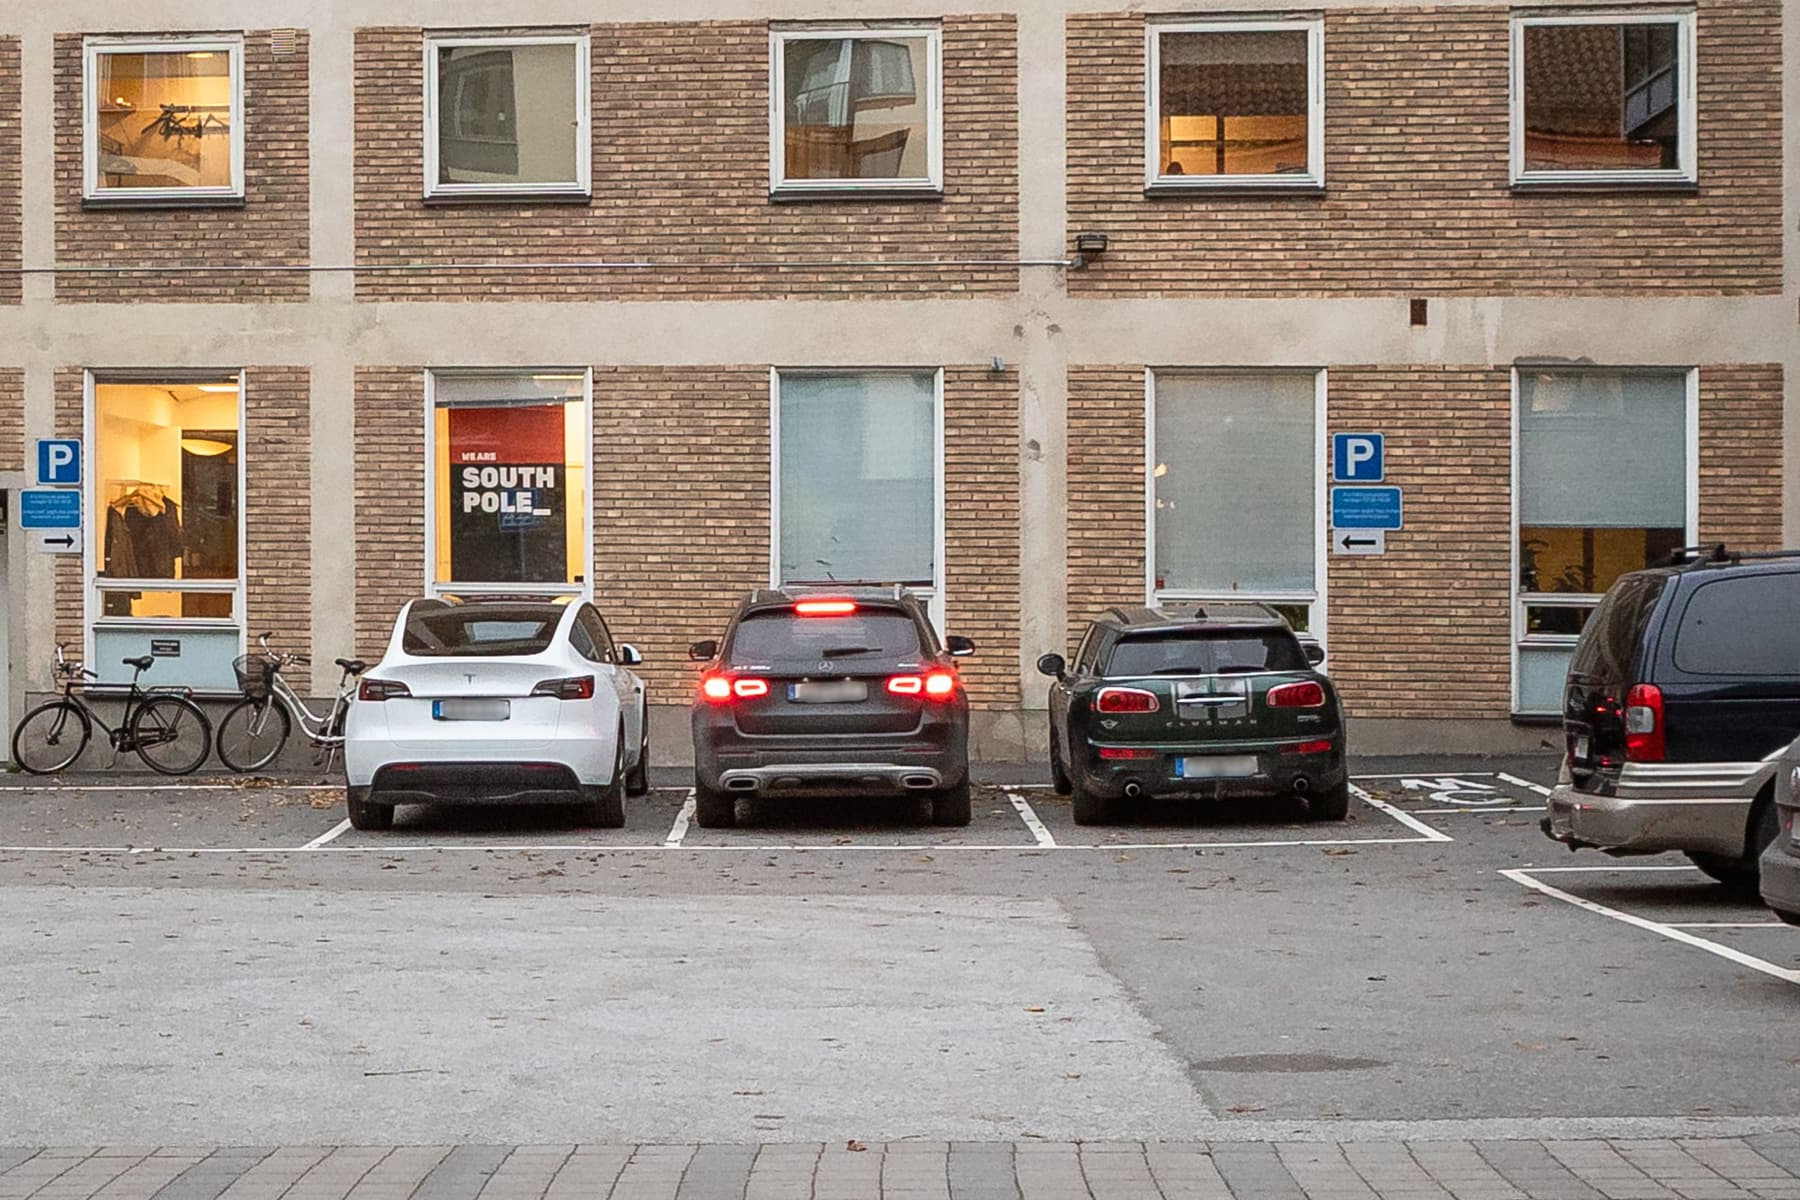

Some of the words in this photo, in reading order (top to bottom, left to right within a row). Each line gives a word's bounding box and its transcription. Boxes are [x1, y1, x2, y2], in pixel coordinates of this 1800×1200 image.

[48, 444, 73, 480] P
[461, 452, 476, 461] WE
[477, 452, 497, 461] ARE
[1347, 438, 1375, 477] P
[462, 466, 555, 489] SOUTH
